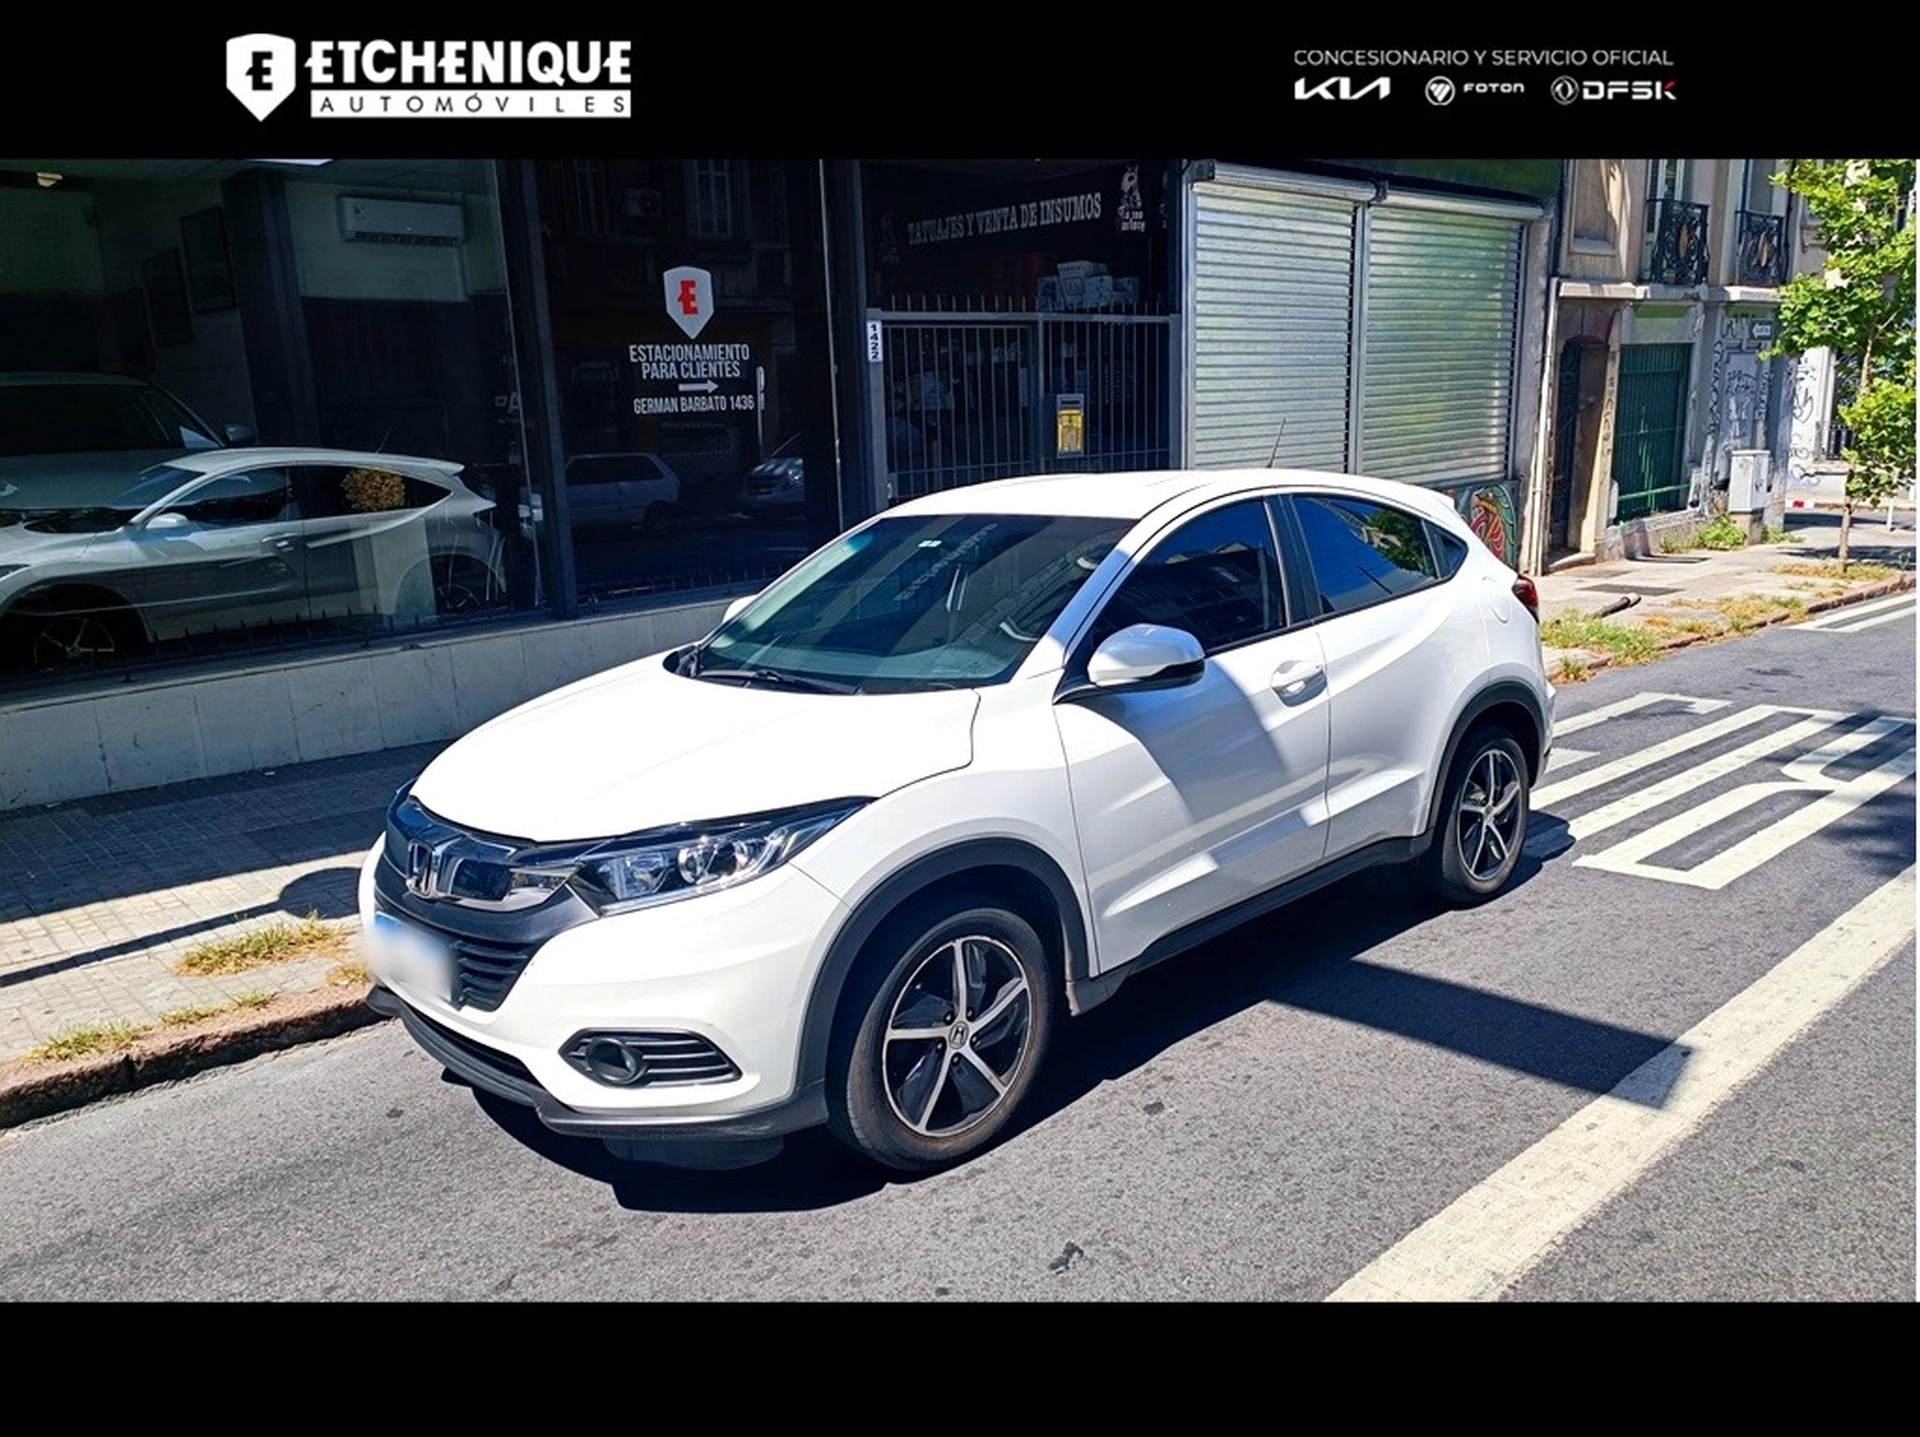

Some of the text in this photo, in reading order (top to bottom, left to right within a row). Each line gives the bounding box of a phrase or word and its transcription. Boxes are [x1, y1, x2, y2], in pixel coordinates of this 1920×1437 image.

[907, 215, 964, 244] TATUAJES
[965, 212, 974, 237] Y
[976, 205, 1018, 235] VENTA
[1020, 201, 1038, 228] DE
[1040, 192, 1101, 225] INSUMOS
[870, 323, 879, 359] 1422
[629, 344, 750, 362] ESTACIONAMIENTO
[642, 360, 741, 380] PARA CLIENTES
[633, 394, 755, 414] GERMAN BARBATO 1436
